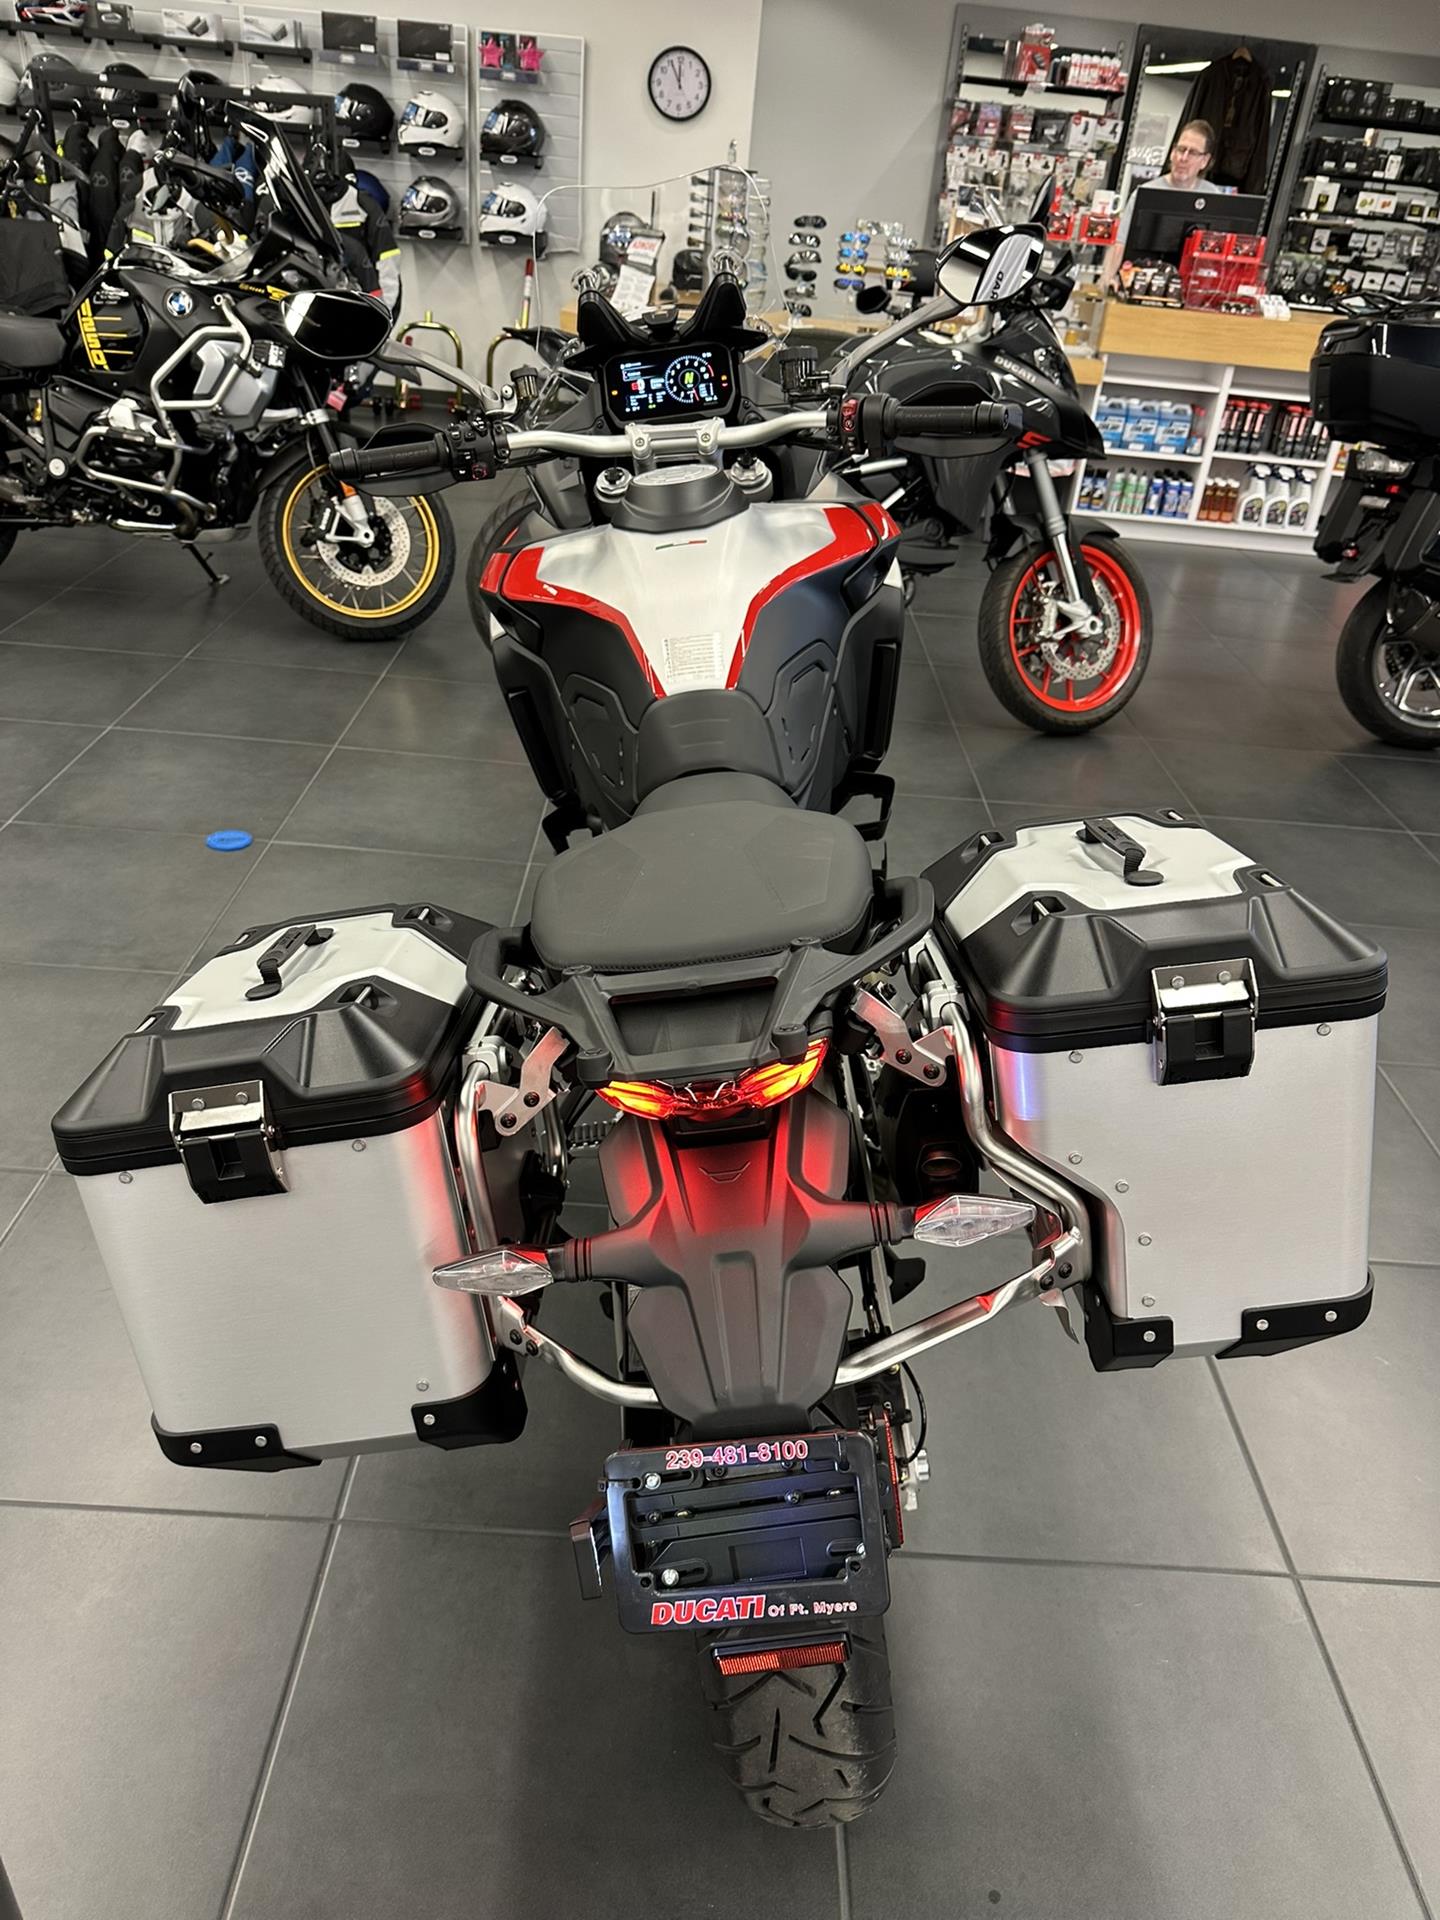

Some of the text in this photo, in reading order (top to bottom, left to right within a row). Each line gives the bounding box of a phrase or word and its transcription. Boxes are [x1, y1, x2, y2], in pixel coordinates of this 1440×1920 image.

[994, 355, 1037, 383] DUCATI
[665, 1439, 808, 1470] 239-481-8100
[651, 1594, 858, 1625] DUCATI Of Ft. Myers
